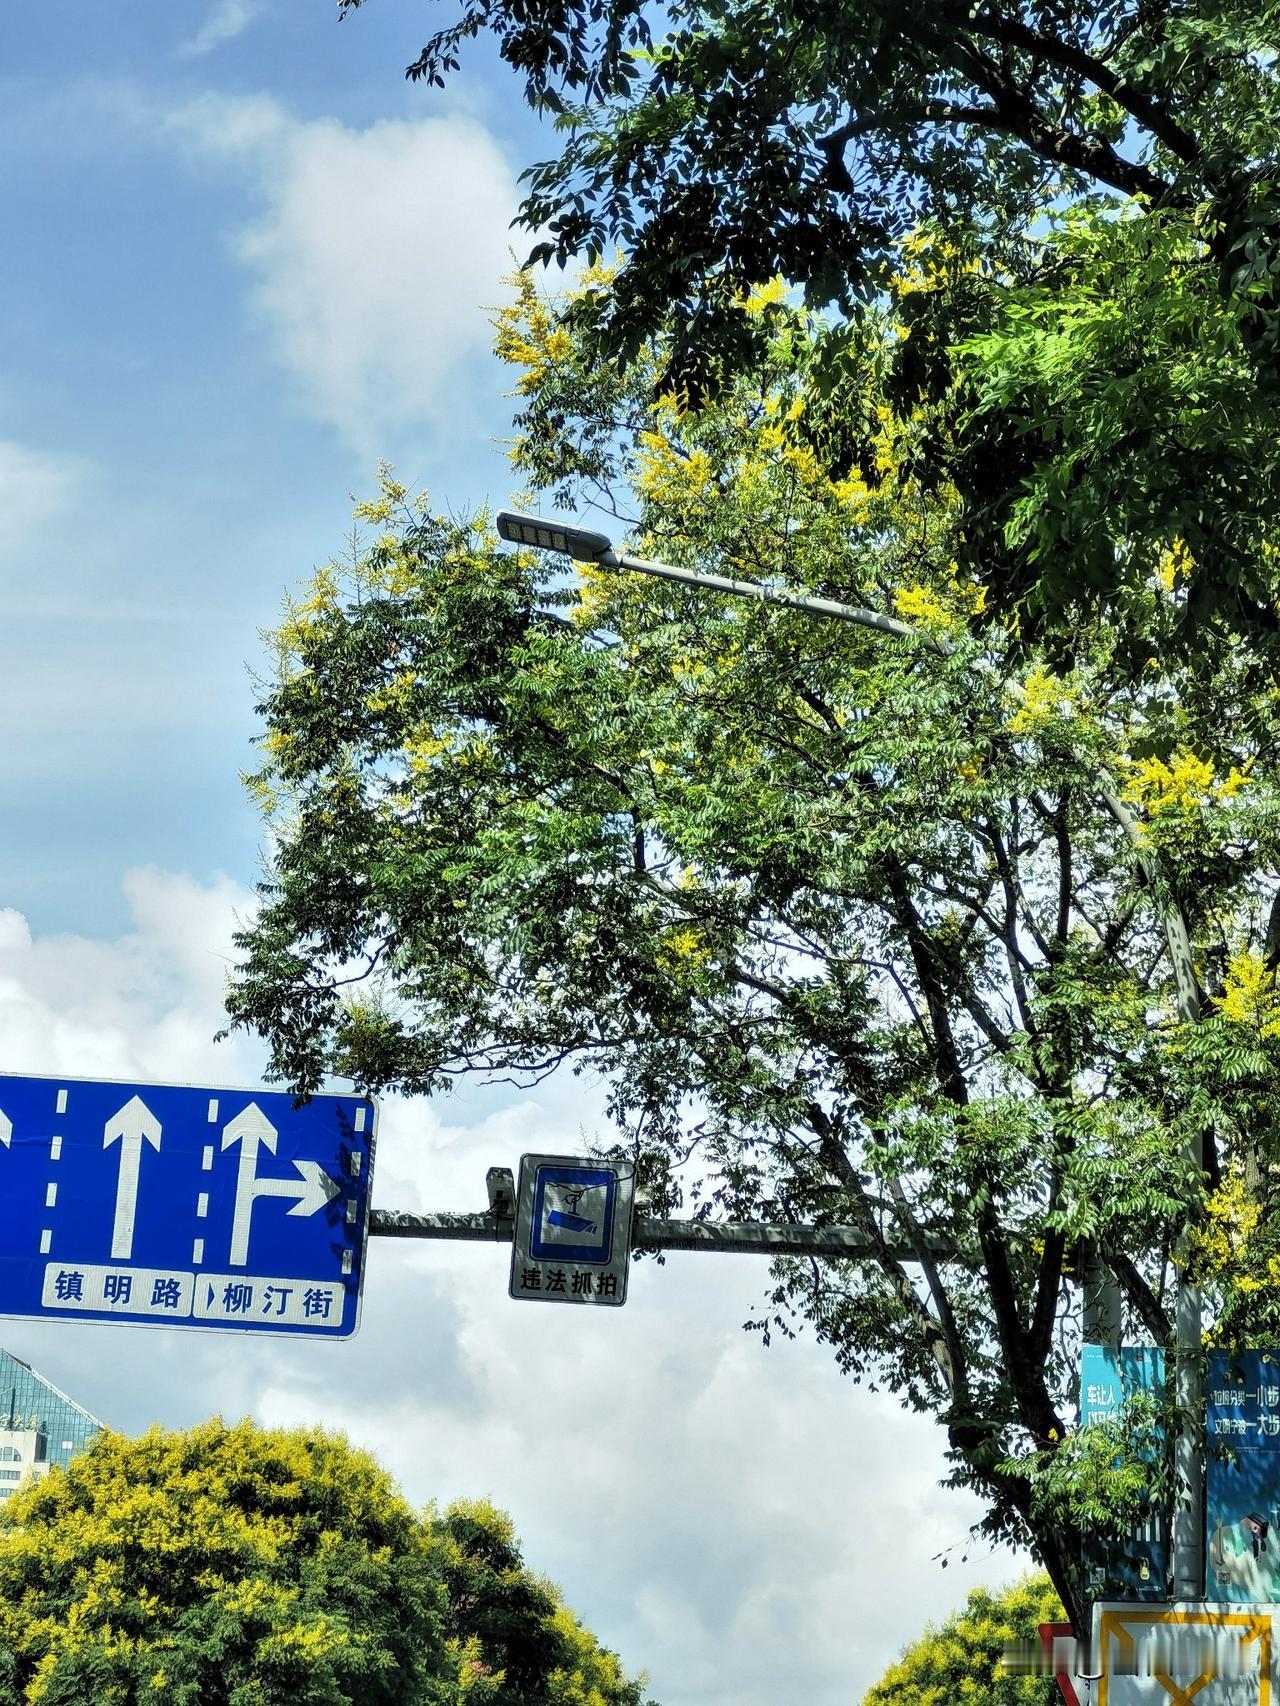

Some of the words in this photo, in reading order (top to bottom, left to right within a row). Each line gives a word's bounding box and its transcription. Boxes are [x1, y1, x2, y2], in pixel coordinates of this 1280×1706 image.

[54, 1270, 182, 1309] 镇明路
[520, 1267, 618, 1297] 违法抓拍
[222, 1282, 333, 1319] 柳汀街
[1087, 1384, 1116, 1406] 车让人
